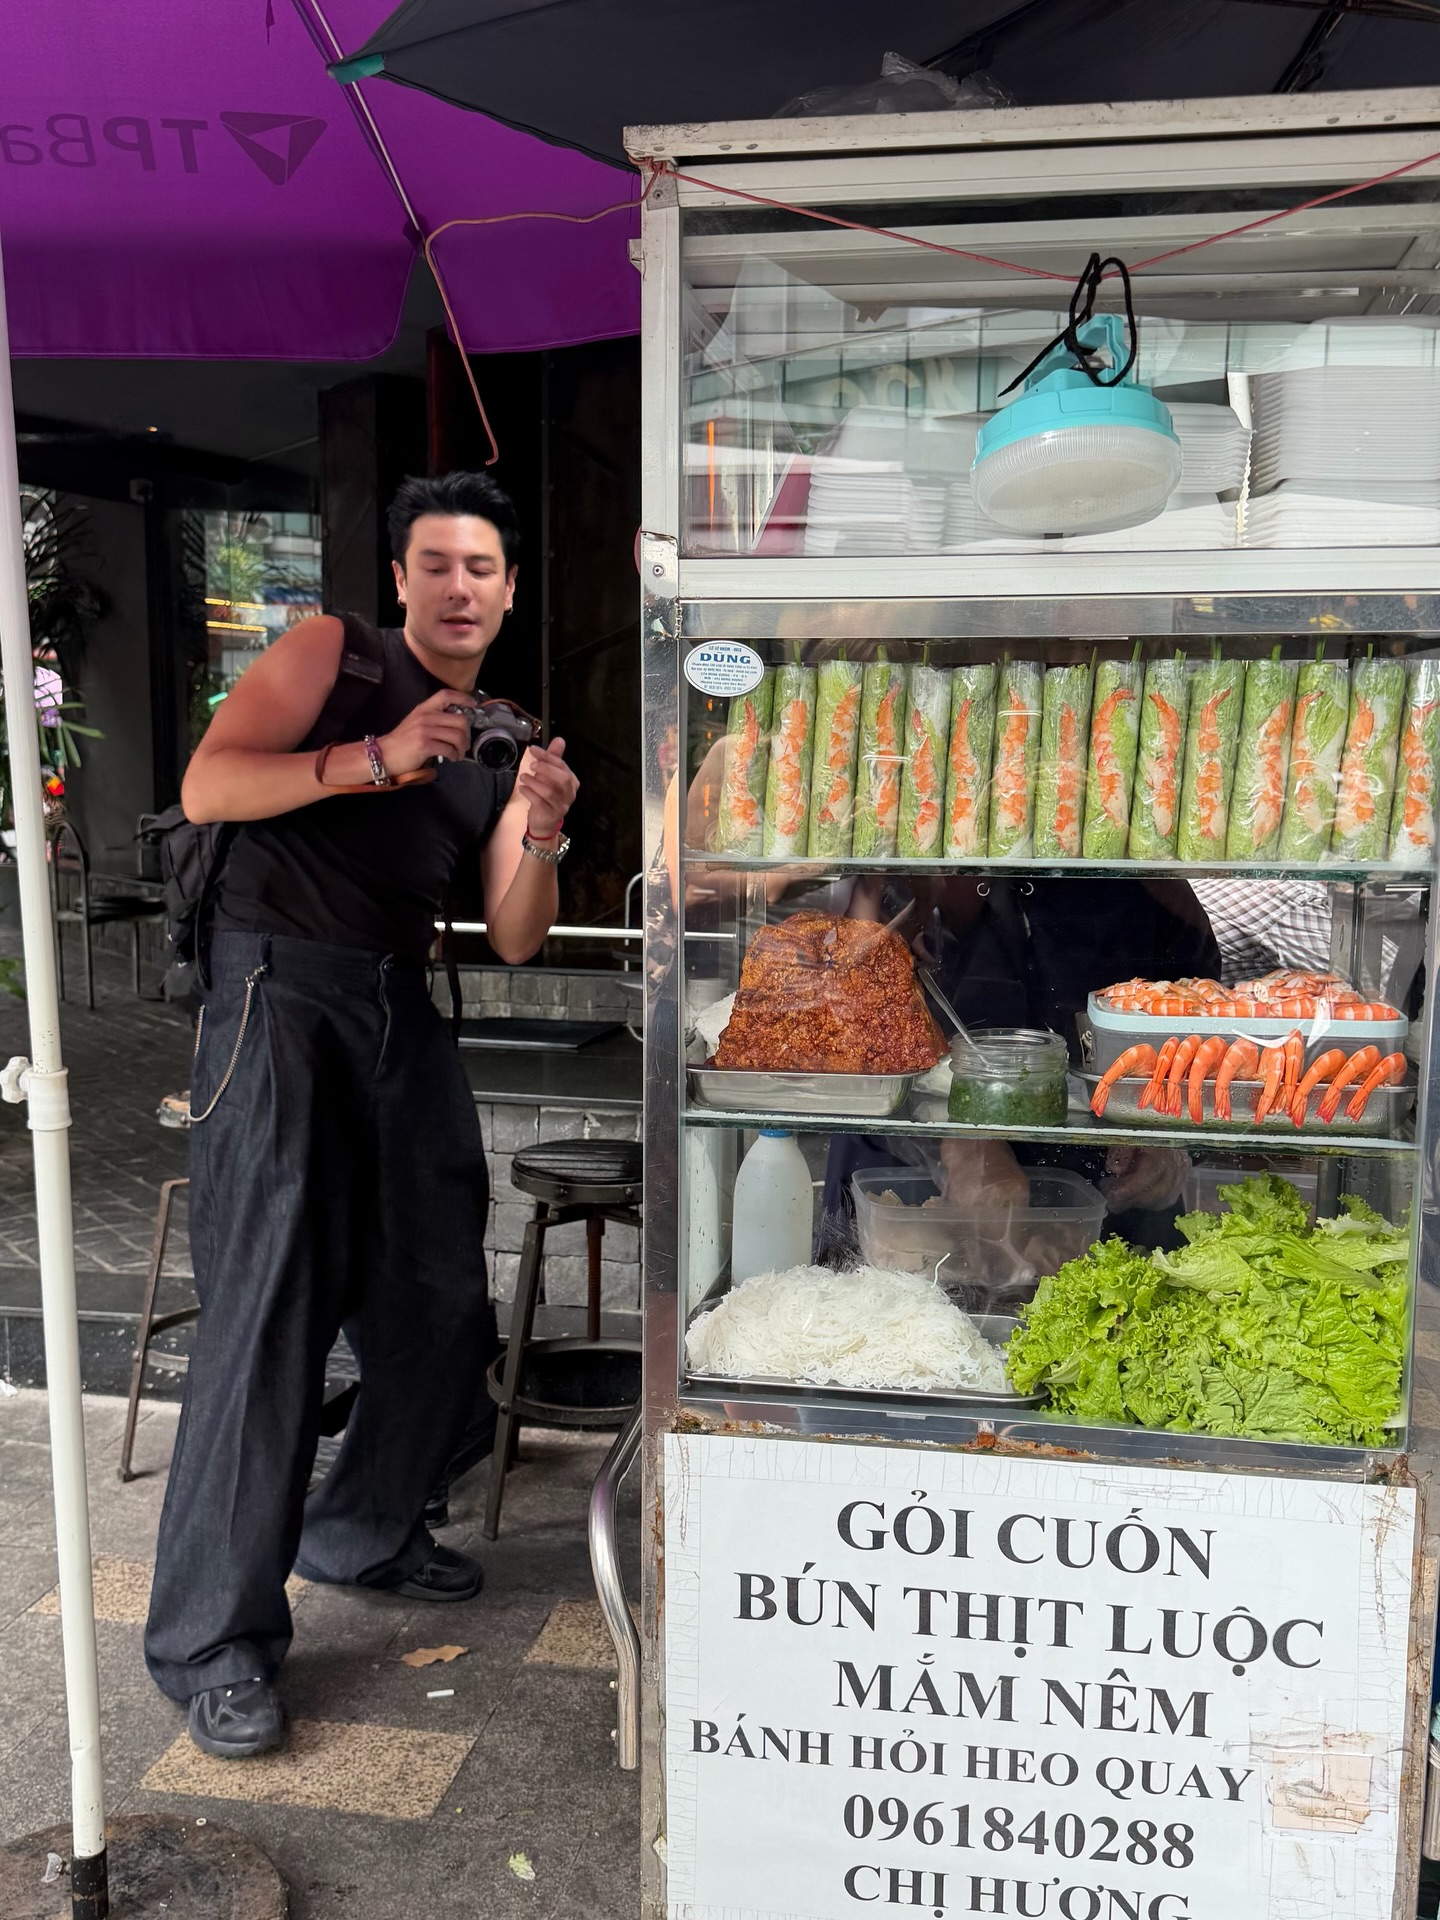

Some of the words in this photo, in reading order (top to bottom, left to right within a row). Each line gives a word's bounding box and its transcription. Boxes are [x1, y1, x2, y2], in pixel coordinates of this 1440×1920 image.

[699, 651, 751, 664] DŨNG
[837, 1489, 975, 1559] GỎI
[997, 1507, 1217, 1580] CUỐN
[734, 1561, 882, 1632] BÚN
[903, 1586, 1084, 1659] THỊT
[1107, 1604, 1324, 1677] LUỘC
[832, 1652, 1020, 1722] MẮM
[1039, 1667, 1212, 1739] NÊM
[690, 1713, 831, 1766] BÁNH
[848, 1728, 947, 1776] HỎI
[965, 1745, 1079, 1787] HEO
[1095, 1757, 1254, 1802] QUAY
[843, 1794, 1194, 1869] 0961840288
[843, 1865, 950, 1919] CHỊ
[965, 1875, 1191, 1920] HƯƠNG
